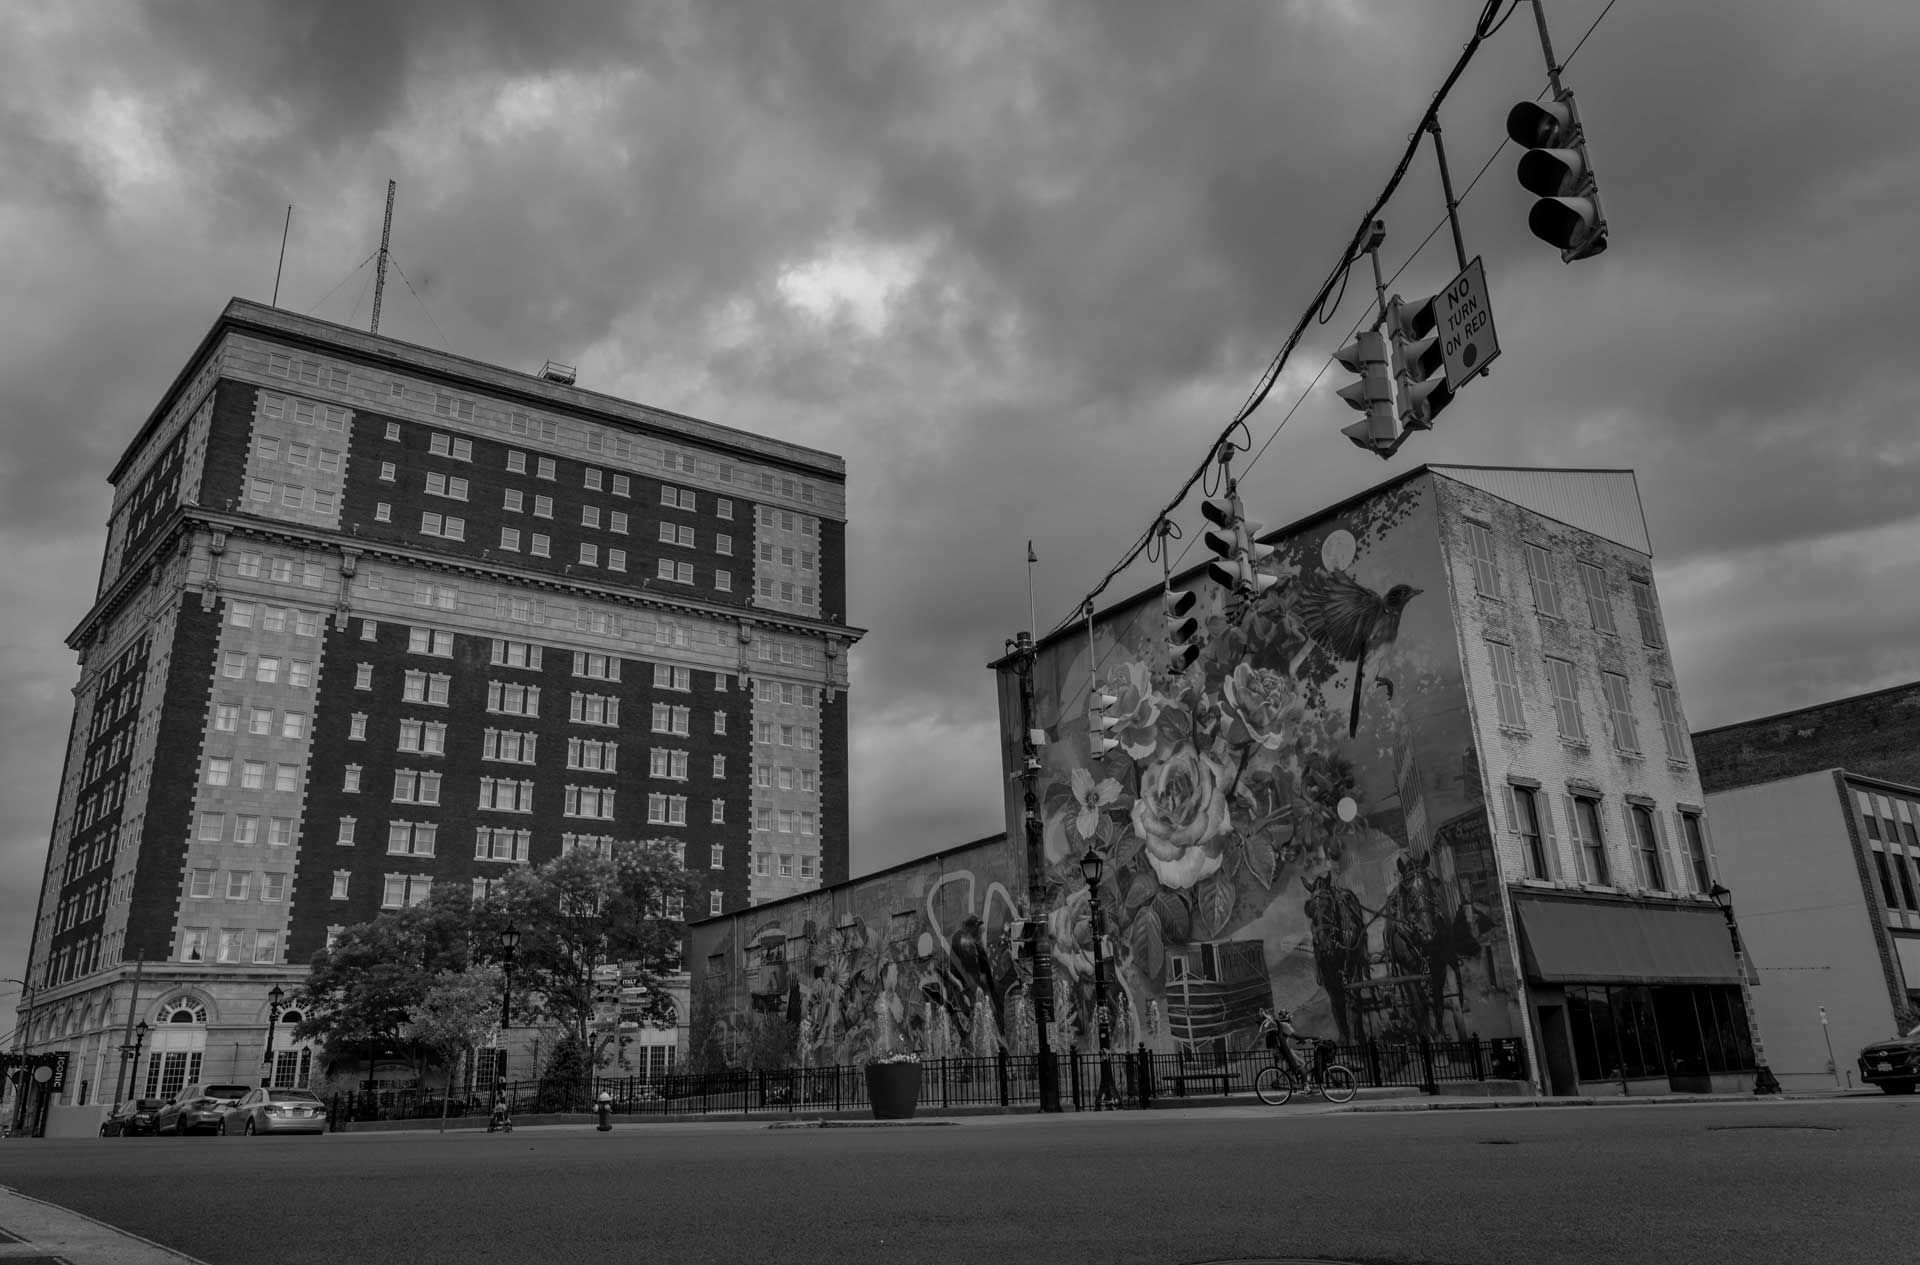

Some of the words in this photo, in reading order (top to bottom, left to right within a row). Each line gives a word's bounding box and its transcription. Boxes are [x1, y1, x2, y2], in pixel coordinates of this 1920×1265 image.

[1448, 278, 1469, 309] NO
[1448, 296, 1477, 331] TURN
[1447, 333, 1461, 356] ON
[1465, 310, 1486, 339] RED
